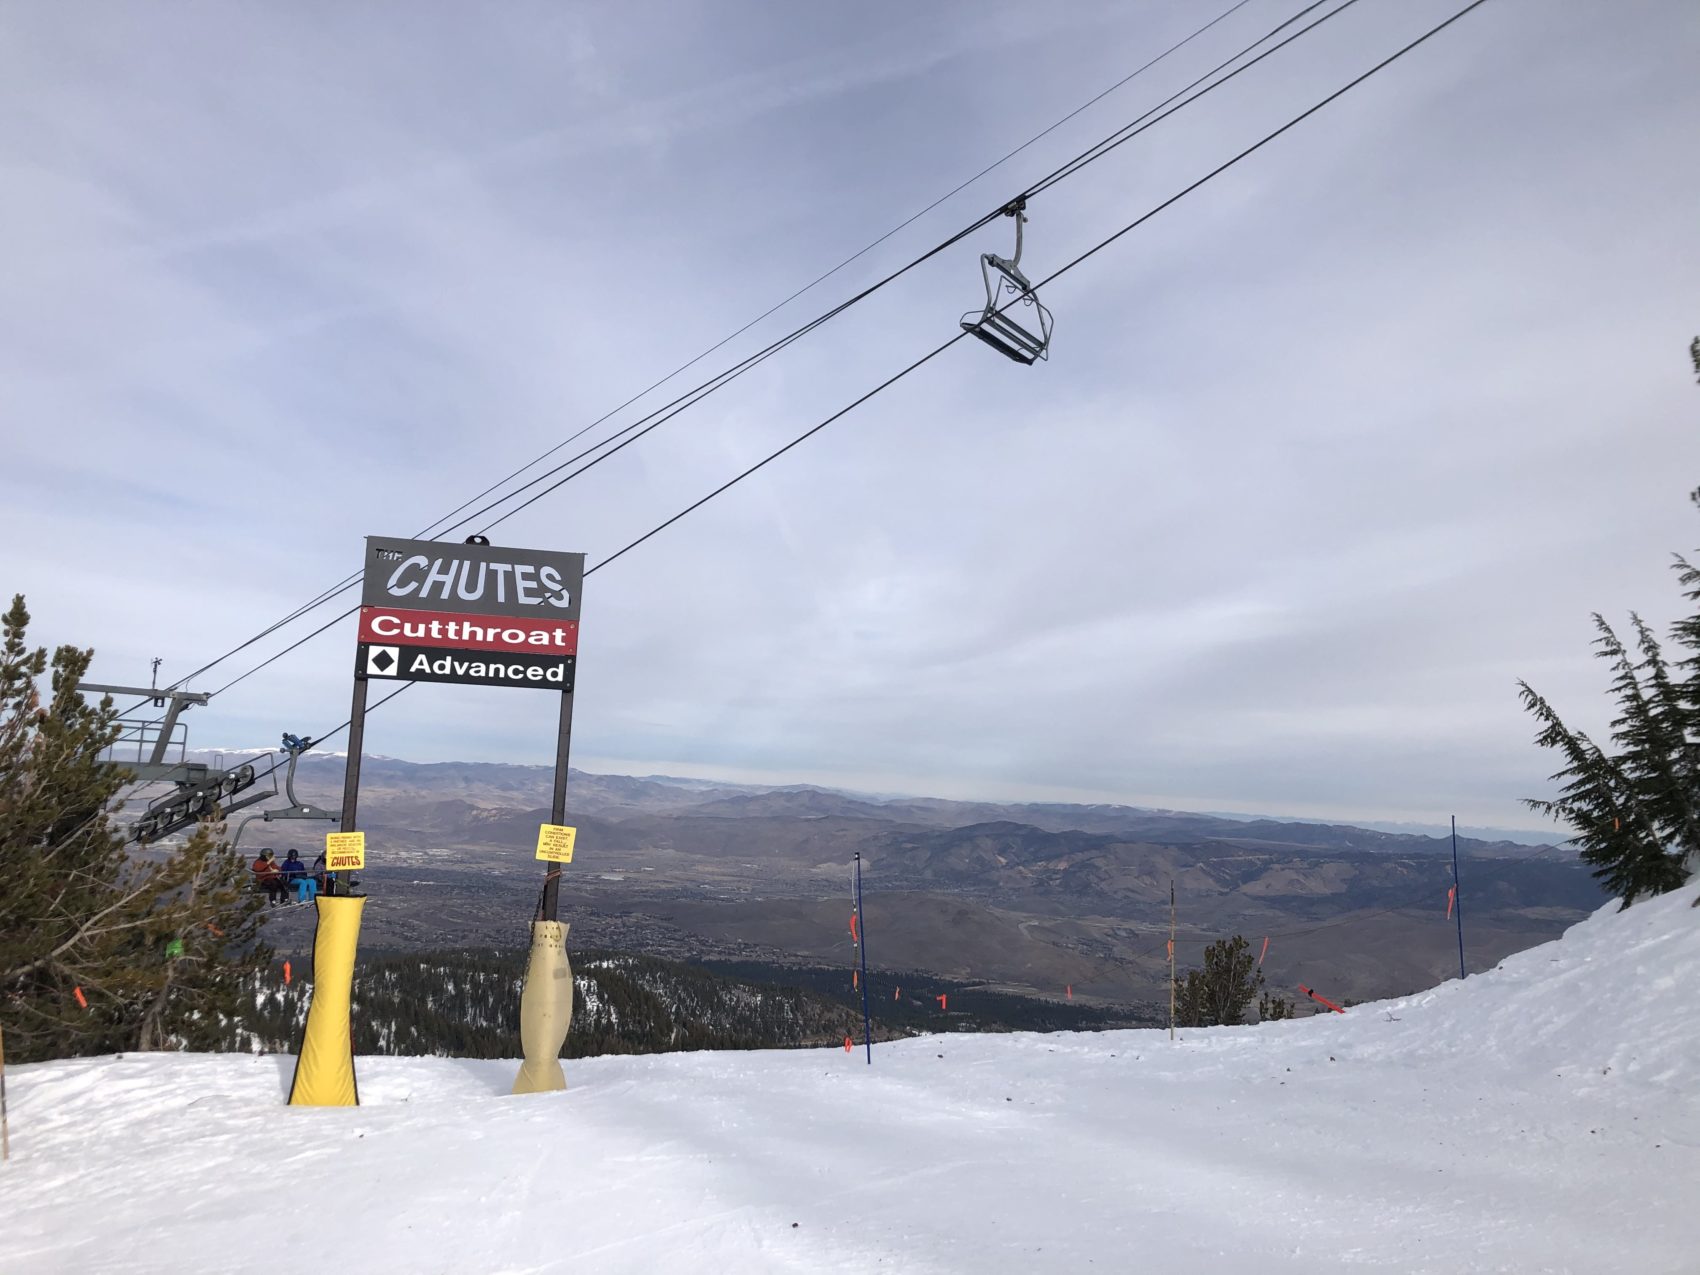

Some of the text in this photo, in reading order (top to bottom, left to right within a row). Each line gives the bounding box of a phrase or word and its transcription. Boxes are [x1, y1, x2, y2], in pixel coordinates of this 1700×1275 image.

[376, 548, 572, 608] THE CHUTES
[371, 615, 566, 646] Cutthroat
[409, 654, 564, 682] Advanced
[331, 856, 361, 866] CHUTES
